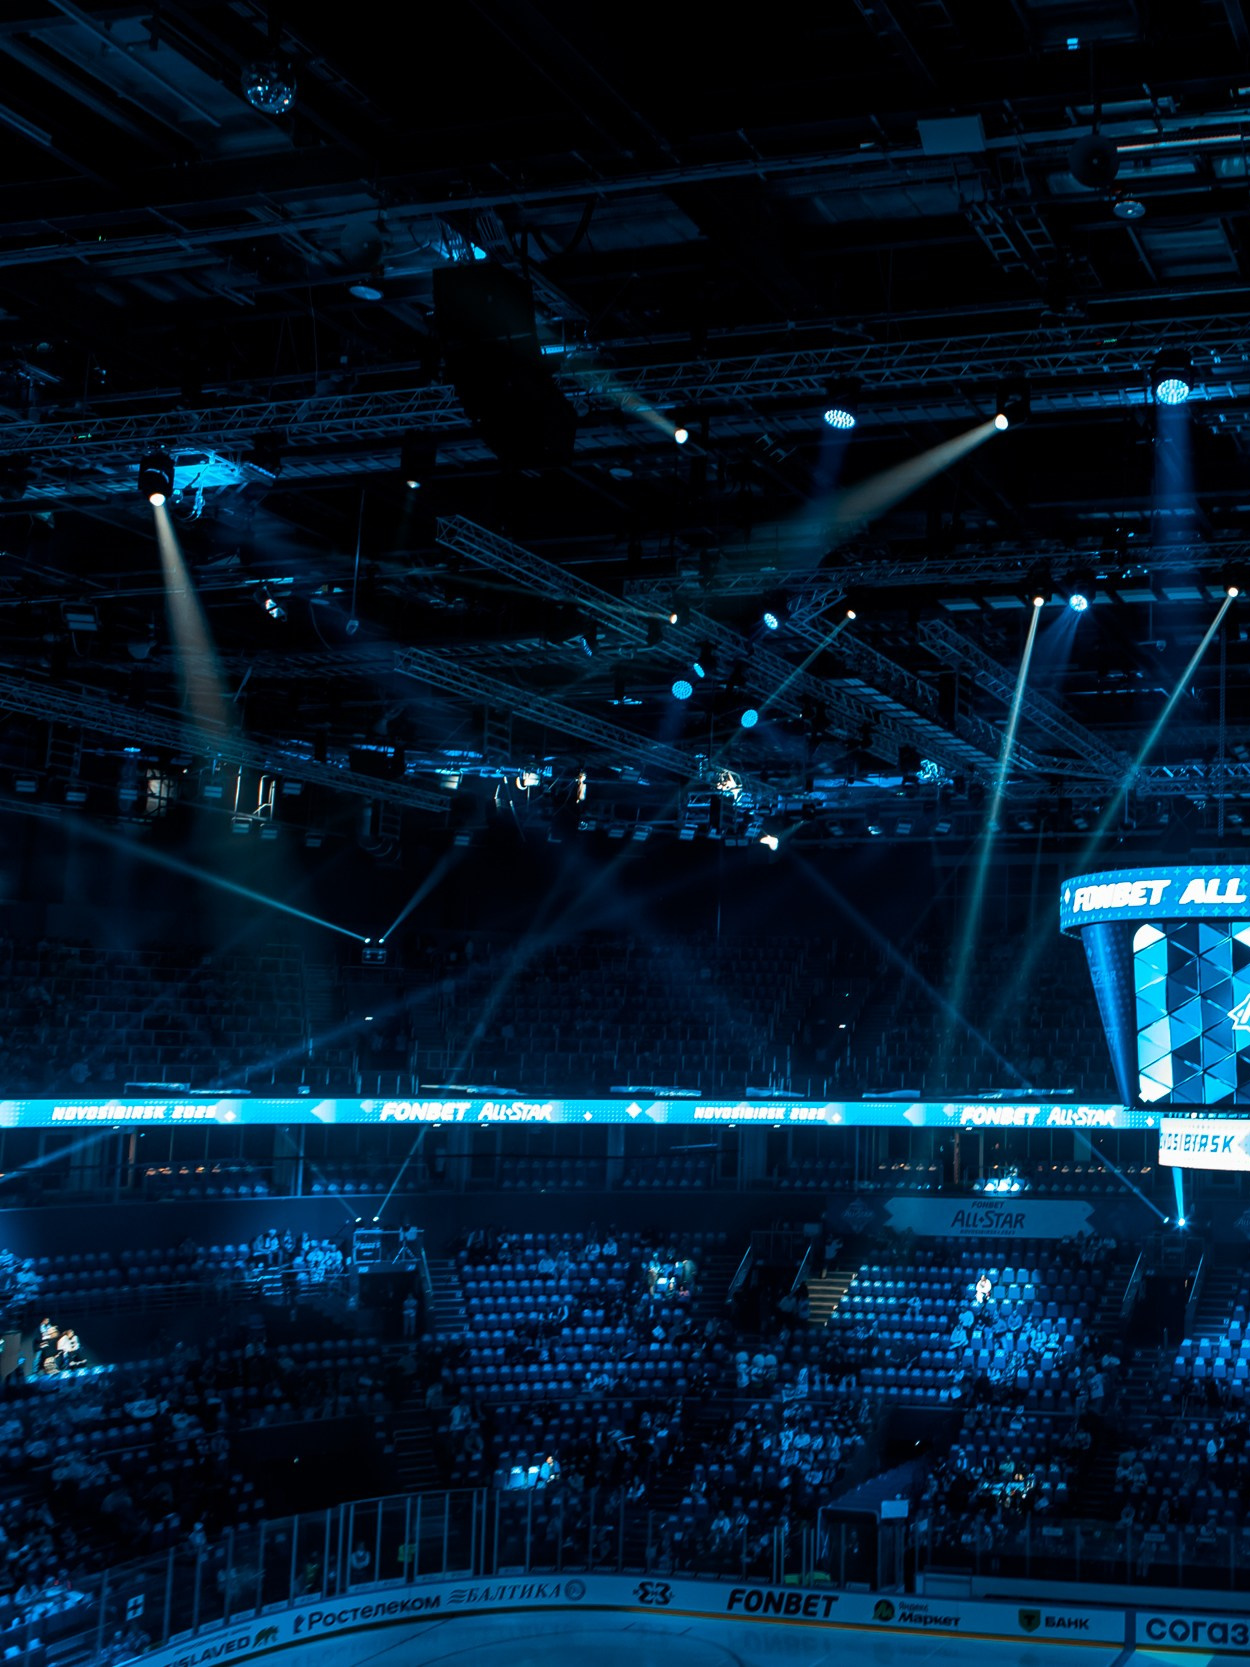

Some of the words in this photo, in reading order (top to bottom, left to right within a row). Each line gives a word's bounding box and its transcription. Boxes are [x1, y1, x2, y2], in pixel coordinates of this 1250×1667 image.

[1073, 880, 1171, 913] FONBET
[1179, 878, 1246, 904] ALL
[51, 1105, 167, 1121] NOVOSIBIRSK
[172, 1105, 218, 1119] 2025
[380, 1101, 471, 1121] FONBET
[693, 1106, 785, 1120] NOVOSIBIRSK
[789, 1107, 826, 1121] 2025
[960, 1106, 1040, 1125] FONBET
[466, 1583, 561, 1603] БАЛТИКА
[307, 1595, 441, 1631] Ростелеком
[727, 1589, 839, 1618] FONBET
[898, 1612, 961, 1627] Маркет
[1045, 1616, 1090, 1630] БАНК
[163, 1635, 250, 1667] SLAVED
